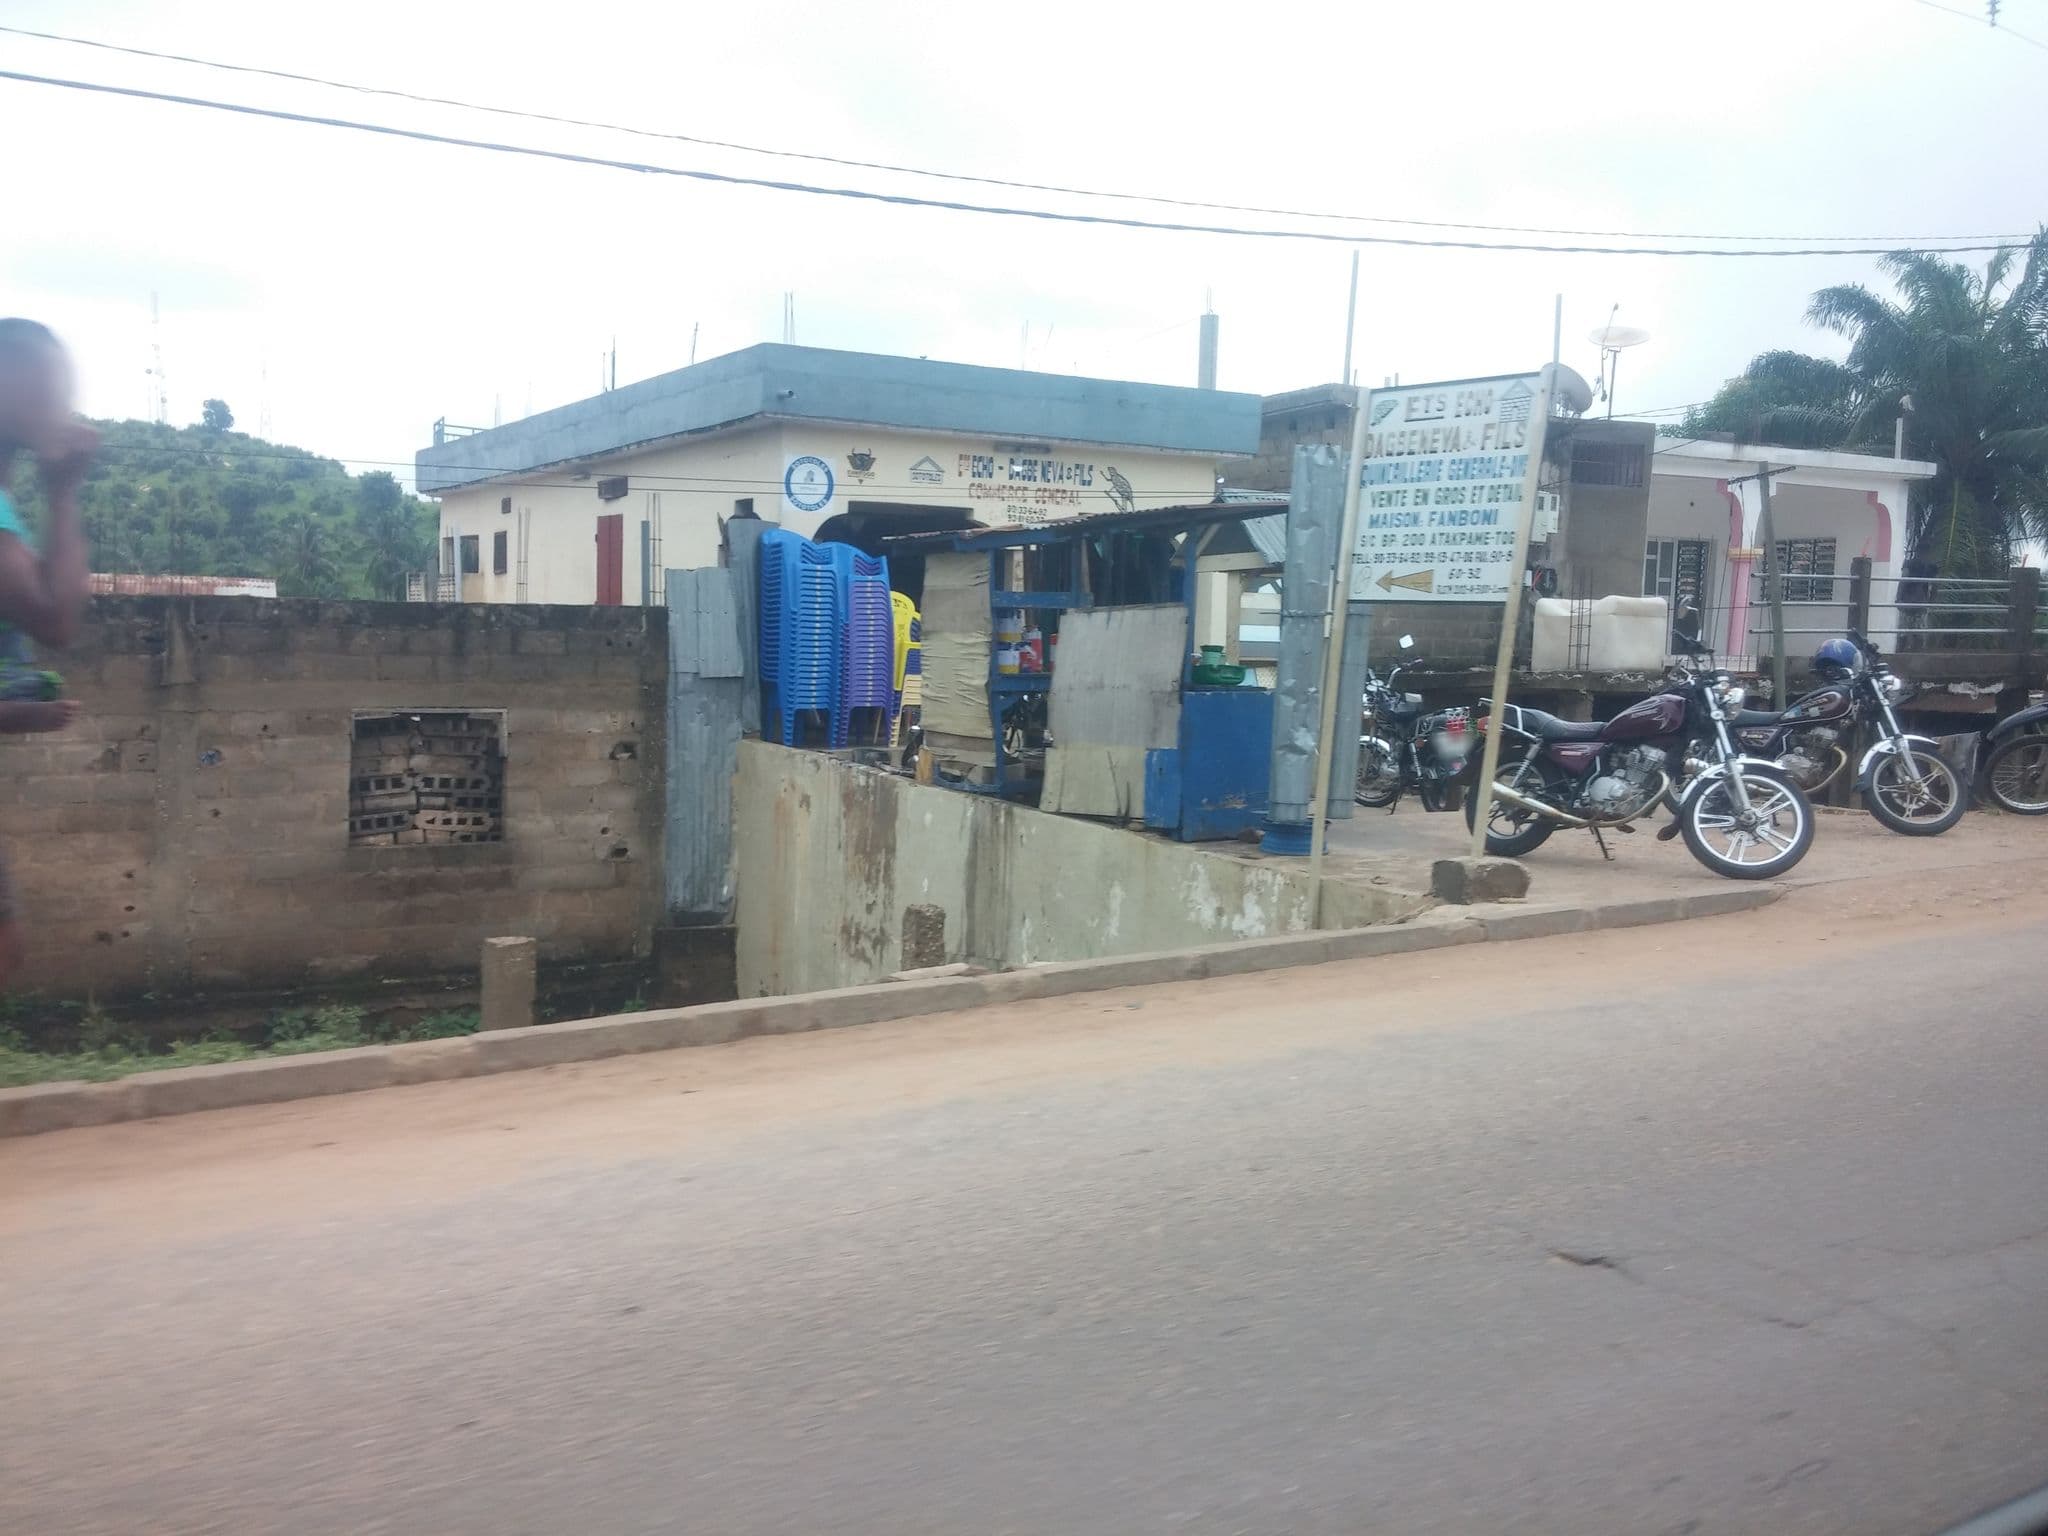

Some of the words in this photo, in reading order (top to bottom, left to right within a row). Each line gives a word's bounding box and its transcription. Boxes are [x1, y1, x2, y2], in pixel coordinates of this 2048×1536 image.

[1480, 422, 1525, 451] FILS
[1073, 463, 1094, 487] FILS
[1371, 488, 1409, 509] VENTE
[1413, 487, 1429, 507] EN
[1435, 485, 1467, 506] GROS
[1471, 484, 1486, 504] ET
[1428, 531, 1515, 547] ATAKPAME-TOG
